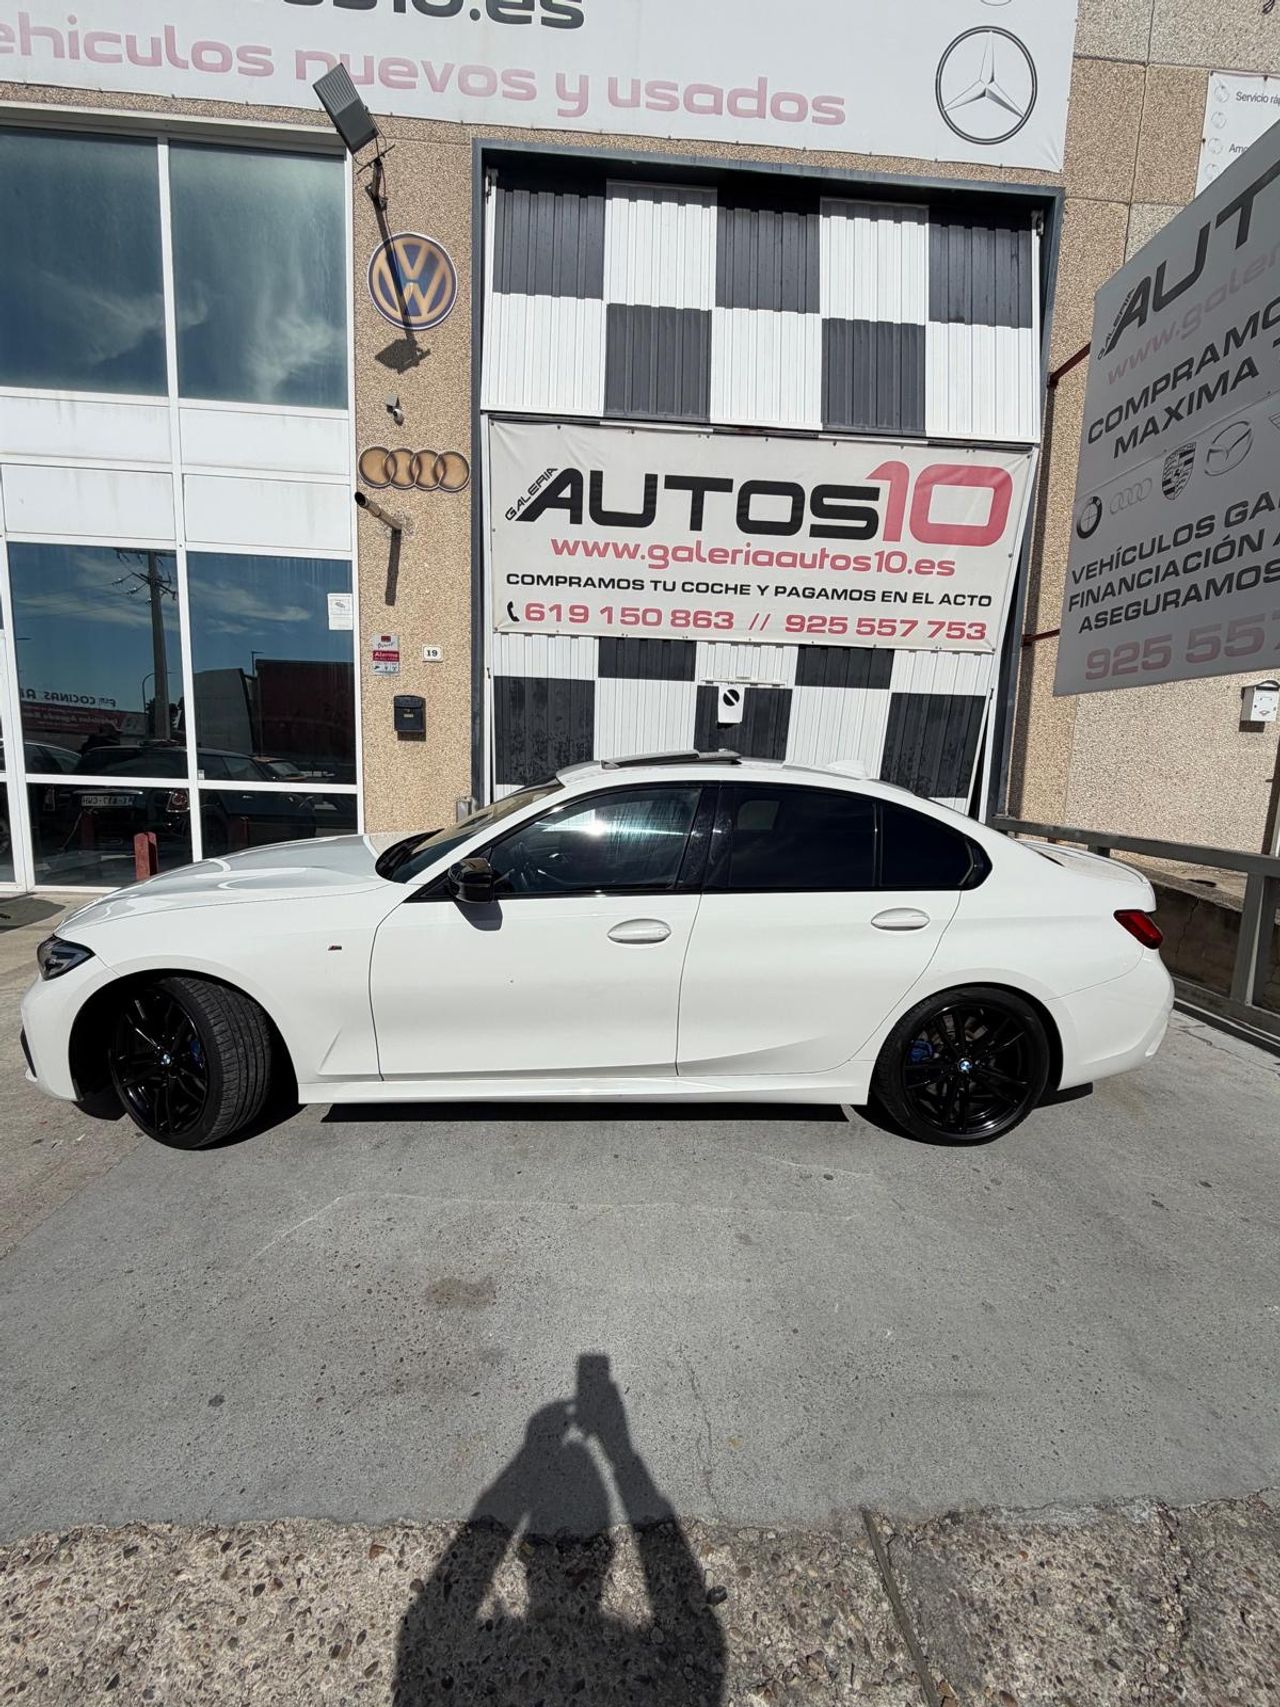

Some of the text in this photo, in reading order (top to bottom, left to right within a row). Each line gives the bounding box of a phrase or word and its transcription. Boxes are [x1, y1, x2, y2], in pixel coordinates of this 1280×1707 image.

[295, 50, 537, 101] nuevos
[555, 72, 590, 118] y
[607, 75, 846, 126] usados
[1236, 91, 1269, 103] Servicio
[1113, 356, 1260, 460] MAXIMA
[504, 467, 559, 521] GALERIA
[514, 460, 1013, 547] AUTOS10
[551, 536, 956, 576] www.galeriaautos10.es
[1071, 491, 1280, 585] VEHÍCULOS GA
[506, 573, 992, 607] COMPRAMOS TU COCHE Y PAGAMOS EN EL ACTO
[1068, 528, 1266, 612] FINANCIACIÓN
[1078, 558, 1280, 634] ASEGURAMOS
[524, 602, 590, 625] 619
[599, 606, 663, 627] 150
[669, 609, 735, 631] 863
[784, 616, 848, 635] 925
[855, 617, 919, 638] 557
[926, 620, 987, 641] 753
[426, 649, 438, 658] 19
[1085, 634, 1172, 680] 925
